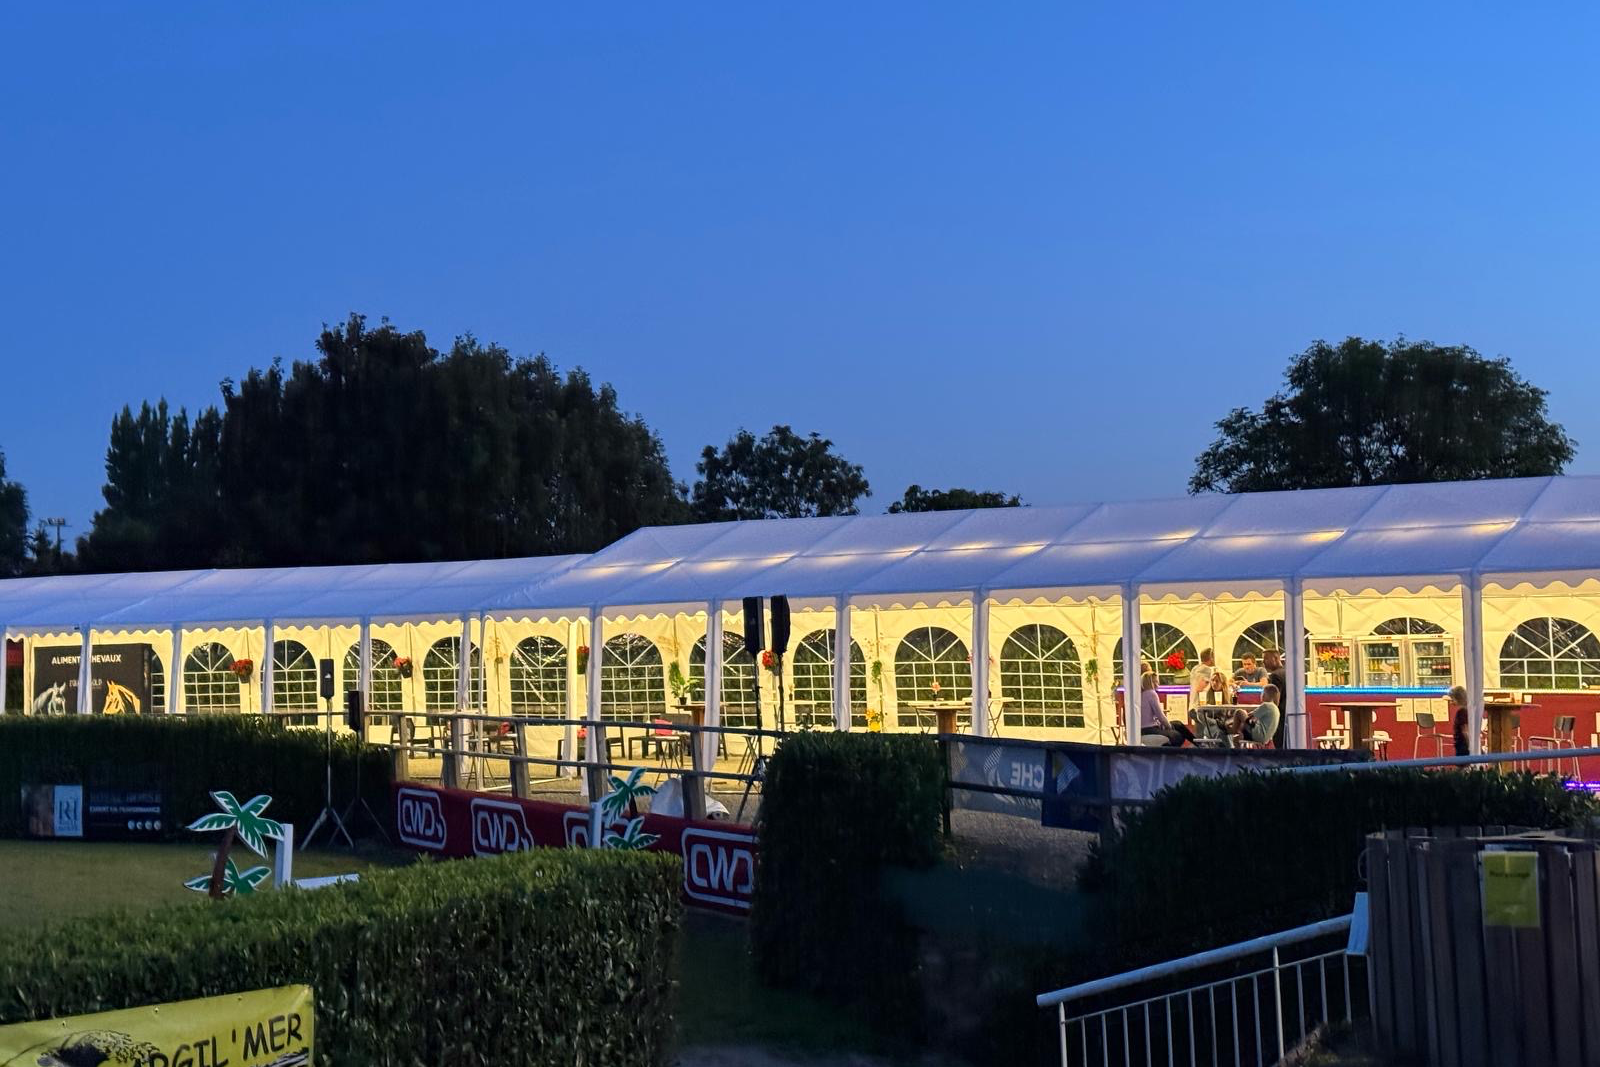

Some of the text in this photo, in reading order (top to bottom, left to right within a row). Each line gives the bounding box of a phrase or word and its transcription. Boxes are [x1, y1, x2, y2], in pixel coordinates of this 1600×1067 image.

[91, 654, 122, 663] HEVAUX
[402, 799, 436, 837] CWD
[476, 810, 520, 851] CWD
